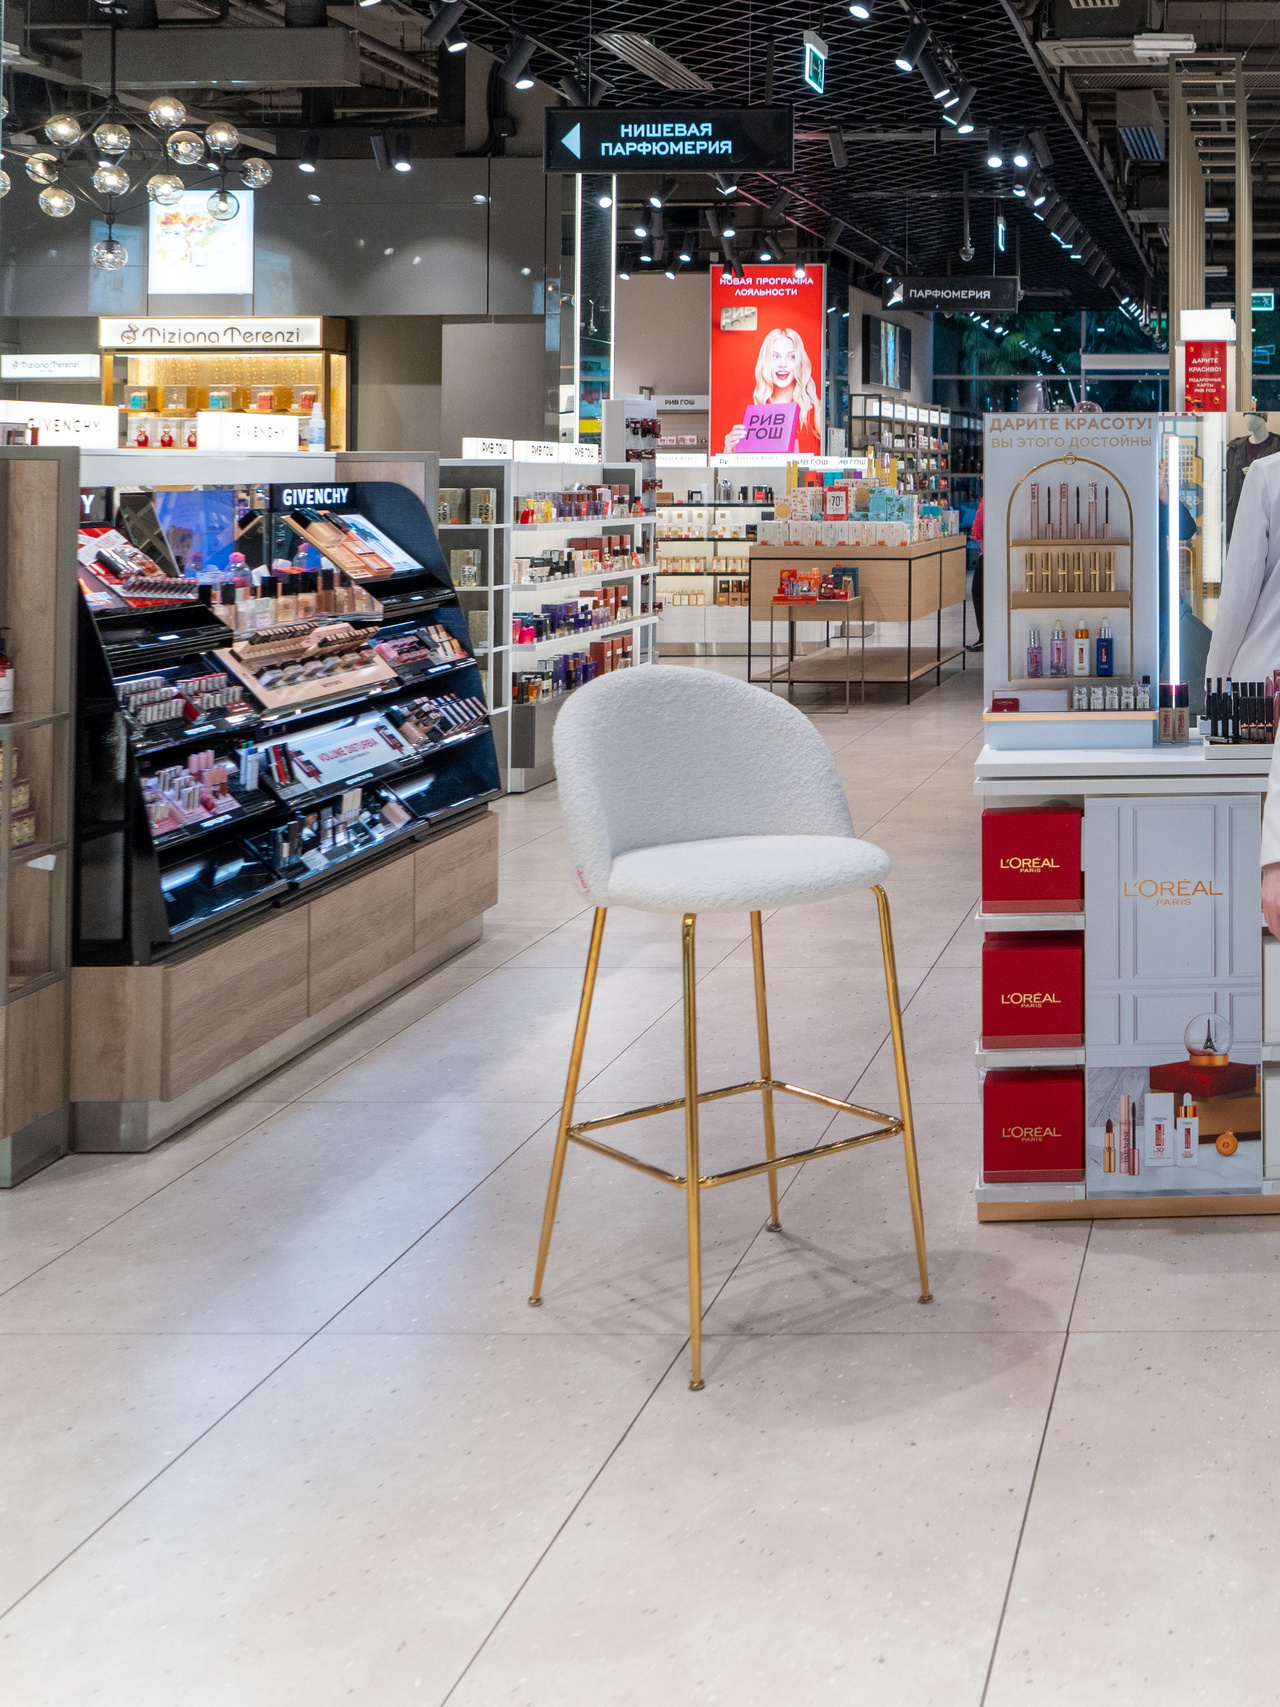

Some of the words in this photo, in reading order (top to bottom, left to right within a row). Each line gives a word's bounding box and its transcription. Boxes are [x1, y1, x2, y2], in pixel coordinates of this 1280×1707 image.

[620, 123, 713, 138] НИШЕВАЯ
[601, 140, 733, 156] ПАРФЮМЕРИЯ
[719, 277, 752, 285] НОВАЯ
[756, 277, 814, 285] ПРОГРАММА
[735, 288, 798, 296] ЛОЯЛЬНОСТИ
[909, 288, 991, 299] ПАРФЮМЕРИЯ
[142, 326, 219, 344] Tiziana
[223, 326, 300, 344] Terenzi
[27, 418, 100, 433] GIVENCHY
[749, 413, 786, 426] РИВ
[989, 417, 1059, 433] ДАРИТЕ
[235, 425, 286, 438] GIVENCHY
[746, 428, 784, 440] ГОШ
[482, 442, 494, 454] РИВ
[991, 438, 1013, 448] ВЫ
[1017, 437, 1065, 448] ЭТОГО
[1069, 434, 1152, 449] ДОСТОЙНЫ
[282, 488, 349, 506] GIVENCHY
[1000, 856, 1061, 870] L'ORÉAL
[1124, 878, 1223, 899] L'ORÉAL
[1156, 898, 1192, 906] PARIS
[1001, 991, 1062, 1004] L'ORÉAL
[1001, 1125, 1062, 1138] L'ORÉAL
